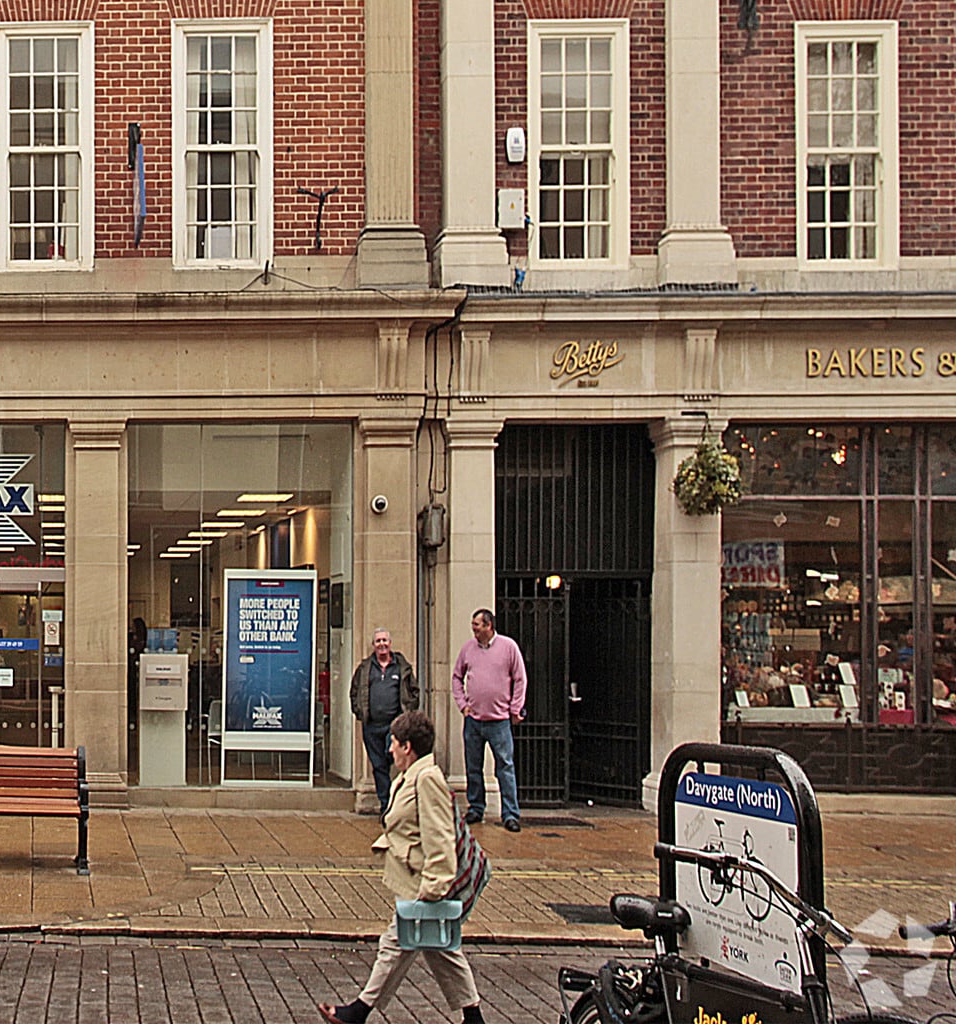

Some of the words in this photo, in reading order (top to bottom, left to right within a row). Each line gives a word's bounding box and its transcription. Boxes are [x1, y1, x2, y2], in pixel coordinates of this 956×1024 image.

[550, 340, 624, 383] Bettys
[806, 347, 926, 378] BAKERS
[937, 351, 956, 377] &
[239, 598, 265, 609] MORE
[267, 598, 300, 609] PEOPLE
[239, 609, 284, 620] SWITCHED
[286, 610, 298, 620] TO
[239, 621, 252, 631] US
[253, 621, 278, 631] THAN
[279, 621, 299, 631] ANY
[239, 631, 267, 642] OTHER
[269, 631, 297, 642] BANK.
[252, 712, 283, 720] HALIFAX
[685, 775, 735, 805] Davygate
[736, 783, 782, 817] (North)
[729, 944, 750, 964] YORK
